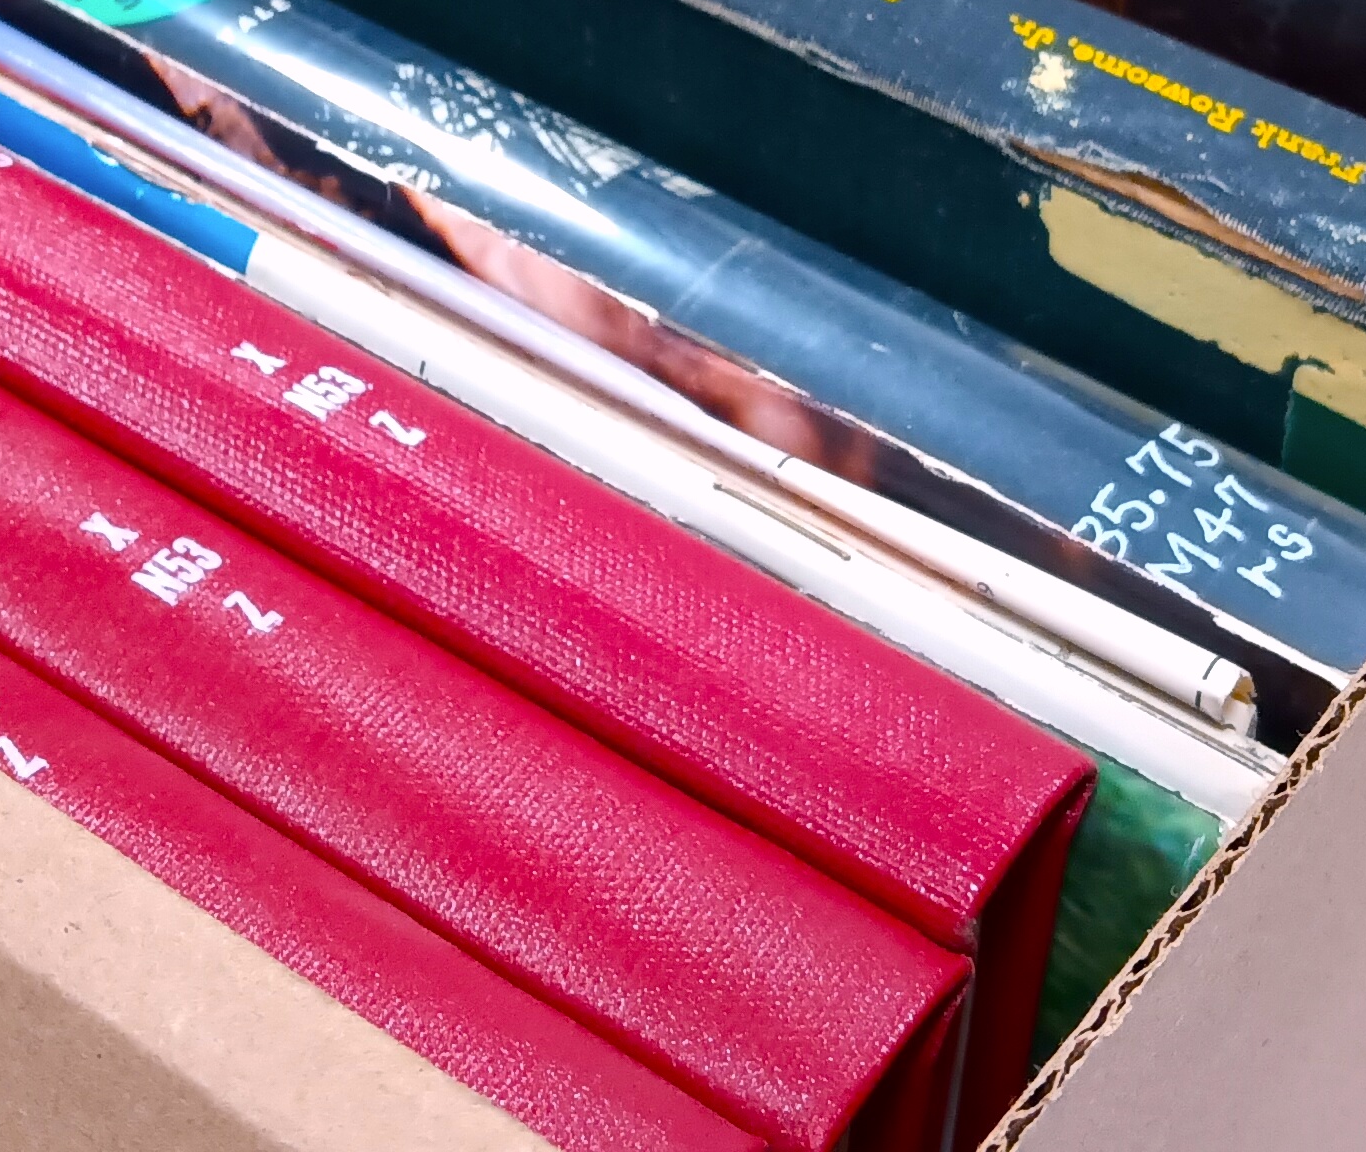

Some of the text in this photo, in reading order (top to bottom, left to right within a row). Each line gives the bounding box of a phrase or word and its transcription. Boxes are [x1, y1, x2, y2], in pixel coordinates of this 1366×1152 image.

[1010, 14, 1056, 49] Jr.
[1068, 36, 1246, 134] Rowsome,
[282, 365, 368, 422] N53
[368, 410, 427, 446] Z
[130, 537, 223, 607] N53
[222, 590, 284, 633] Z
